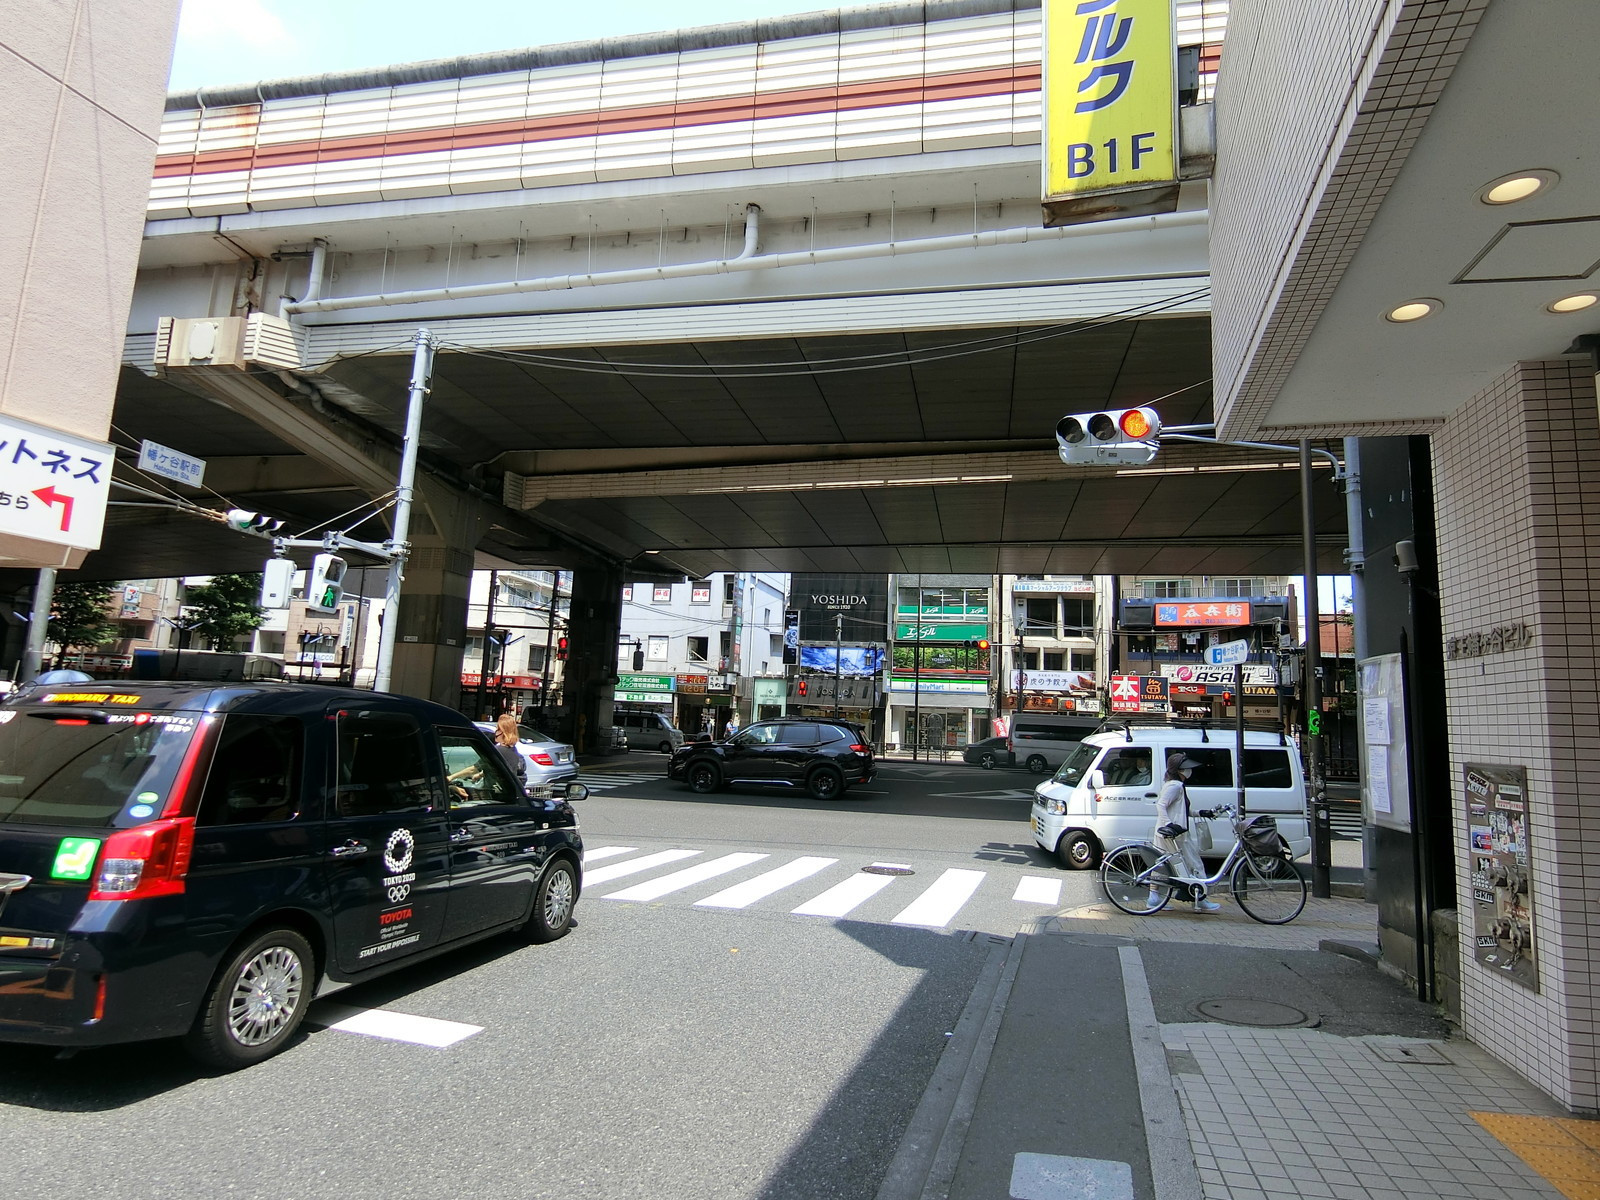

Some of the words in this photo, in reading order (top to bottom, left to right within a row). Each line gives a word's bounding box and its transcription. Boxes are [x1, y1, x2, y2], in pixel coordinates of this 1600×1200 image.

[1067, 132, 1155, 179] B1F
[811, 594, 868, 605] YOSHIDA
[1112, 676, 1139, 700] 本
[110, 694, 142, 704] TAXI
[383, 874, 402, 887] TOKYO
[402, 872, 416, 883] 2020
[380, 908, 413, 925] TOYOTA
[359, 946, 377, 959] START
[377, 942, 392, 953] YOUR
[392, 933, 420, 948] IMPOSSIBLE
